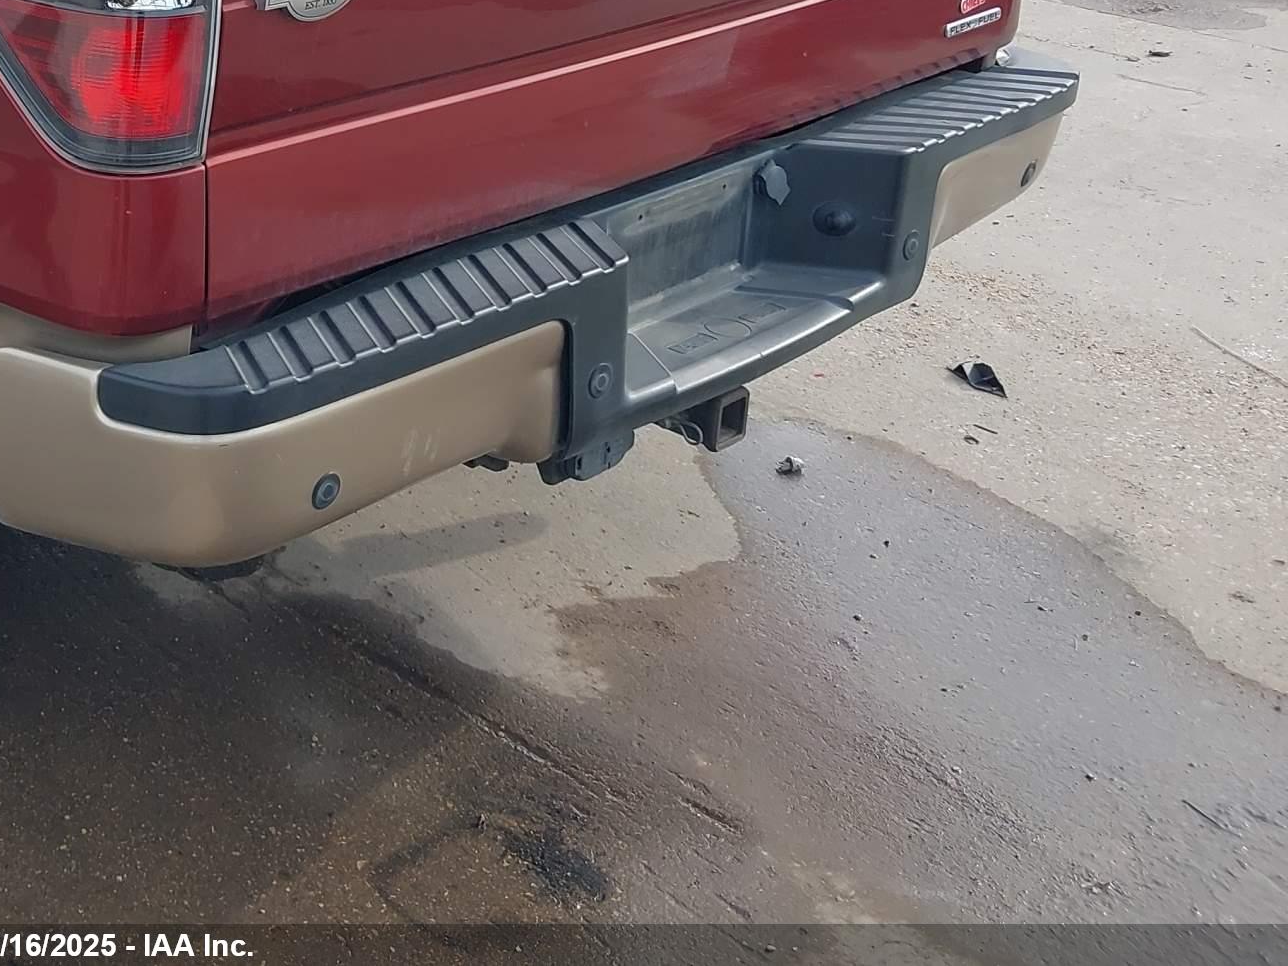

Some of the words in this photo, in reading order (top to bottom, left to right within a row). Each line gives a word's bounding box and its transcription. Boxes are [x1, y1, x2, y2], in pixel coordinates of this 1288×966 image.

[304, 0, 320, 10] EST.
[949, 22, 971, 34] FLEX
[978, 11, 1000, 25] FUEL
